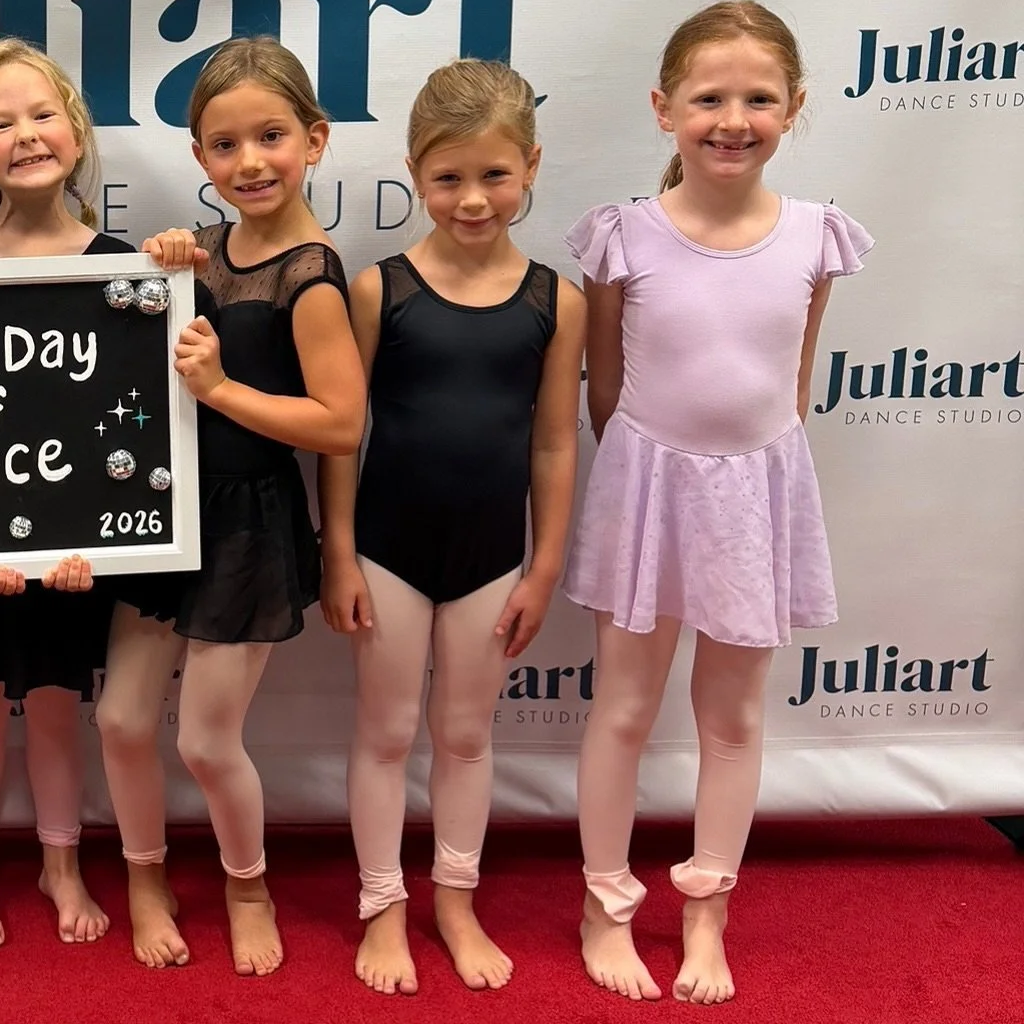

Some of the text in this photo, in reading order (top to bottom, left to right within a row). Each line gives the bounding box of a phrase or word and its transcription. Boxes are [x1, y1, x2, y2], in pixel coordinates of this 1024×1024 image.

[844, 27, 1024, 98] Juliar
[880, 94, 955, 111] DANCE
[4, 325, 97, 381] Day
[814, 347, 1024, 414] Juliart
[845, 409, 1023, 425] DANCE STUDIO
[99, 510, 163, 538] 2026
[788, 644, 995, 706] Juliart
[820, 702, 989, 718] DANCE STUDIO
